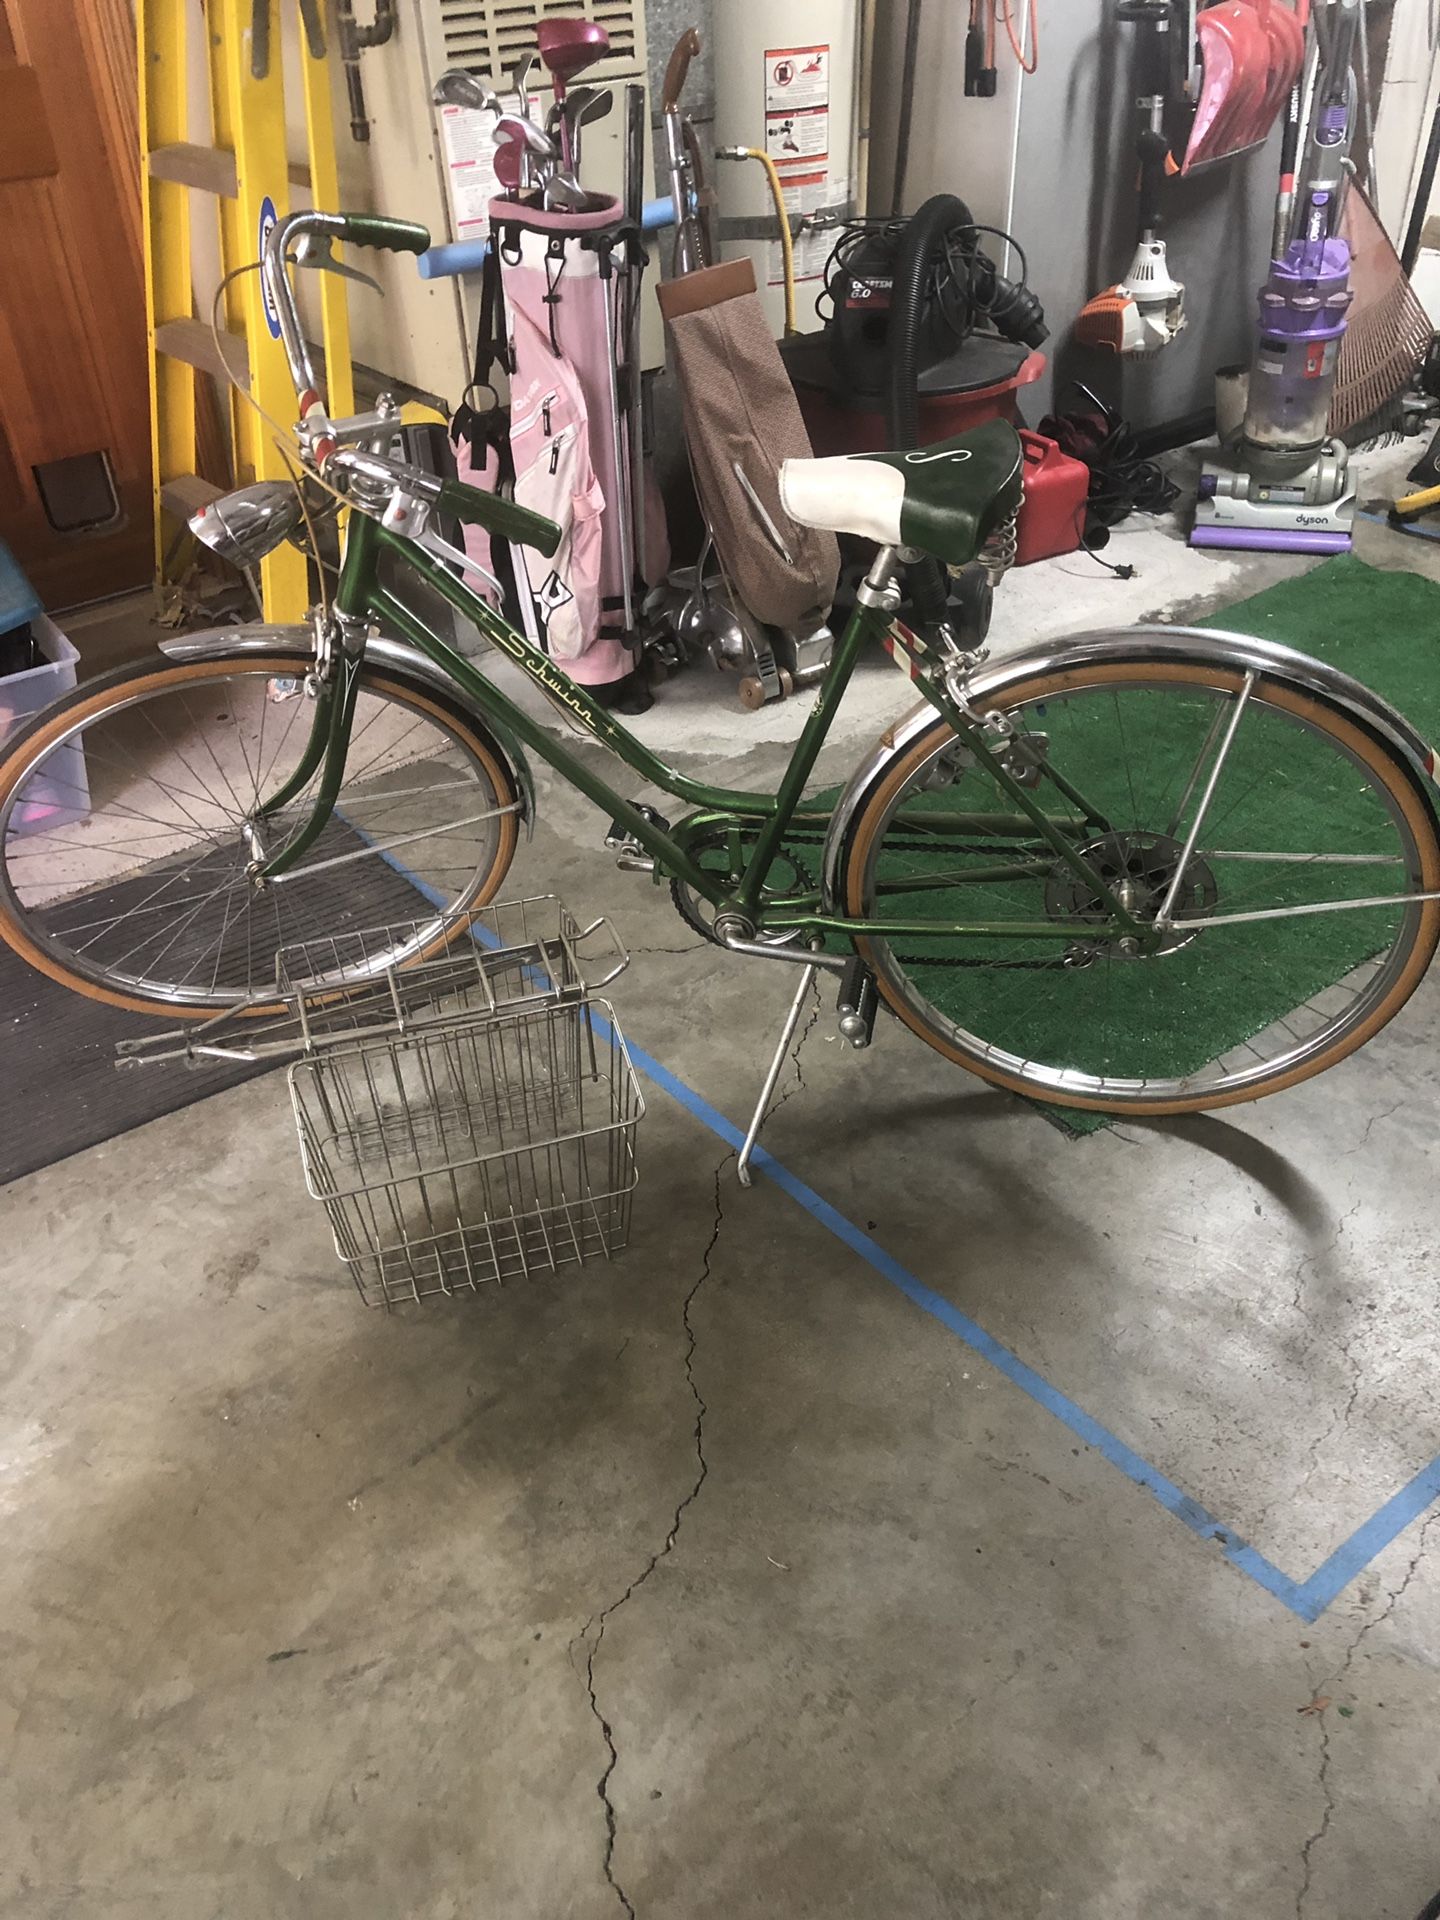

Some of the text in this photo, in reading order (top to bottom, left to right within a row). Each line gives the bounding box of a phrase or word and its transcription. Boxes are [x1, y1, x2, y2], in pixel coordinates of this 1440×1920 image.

[850, 288, 872, 299] 6.0
[1296, 514, 1329, 525] dyson
[490, 630, 596, 727] Schwinn
